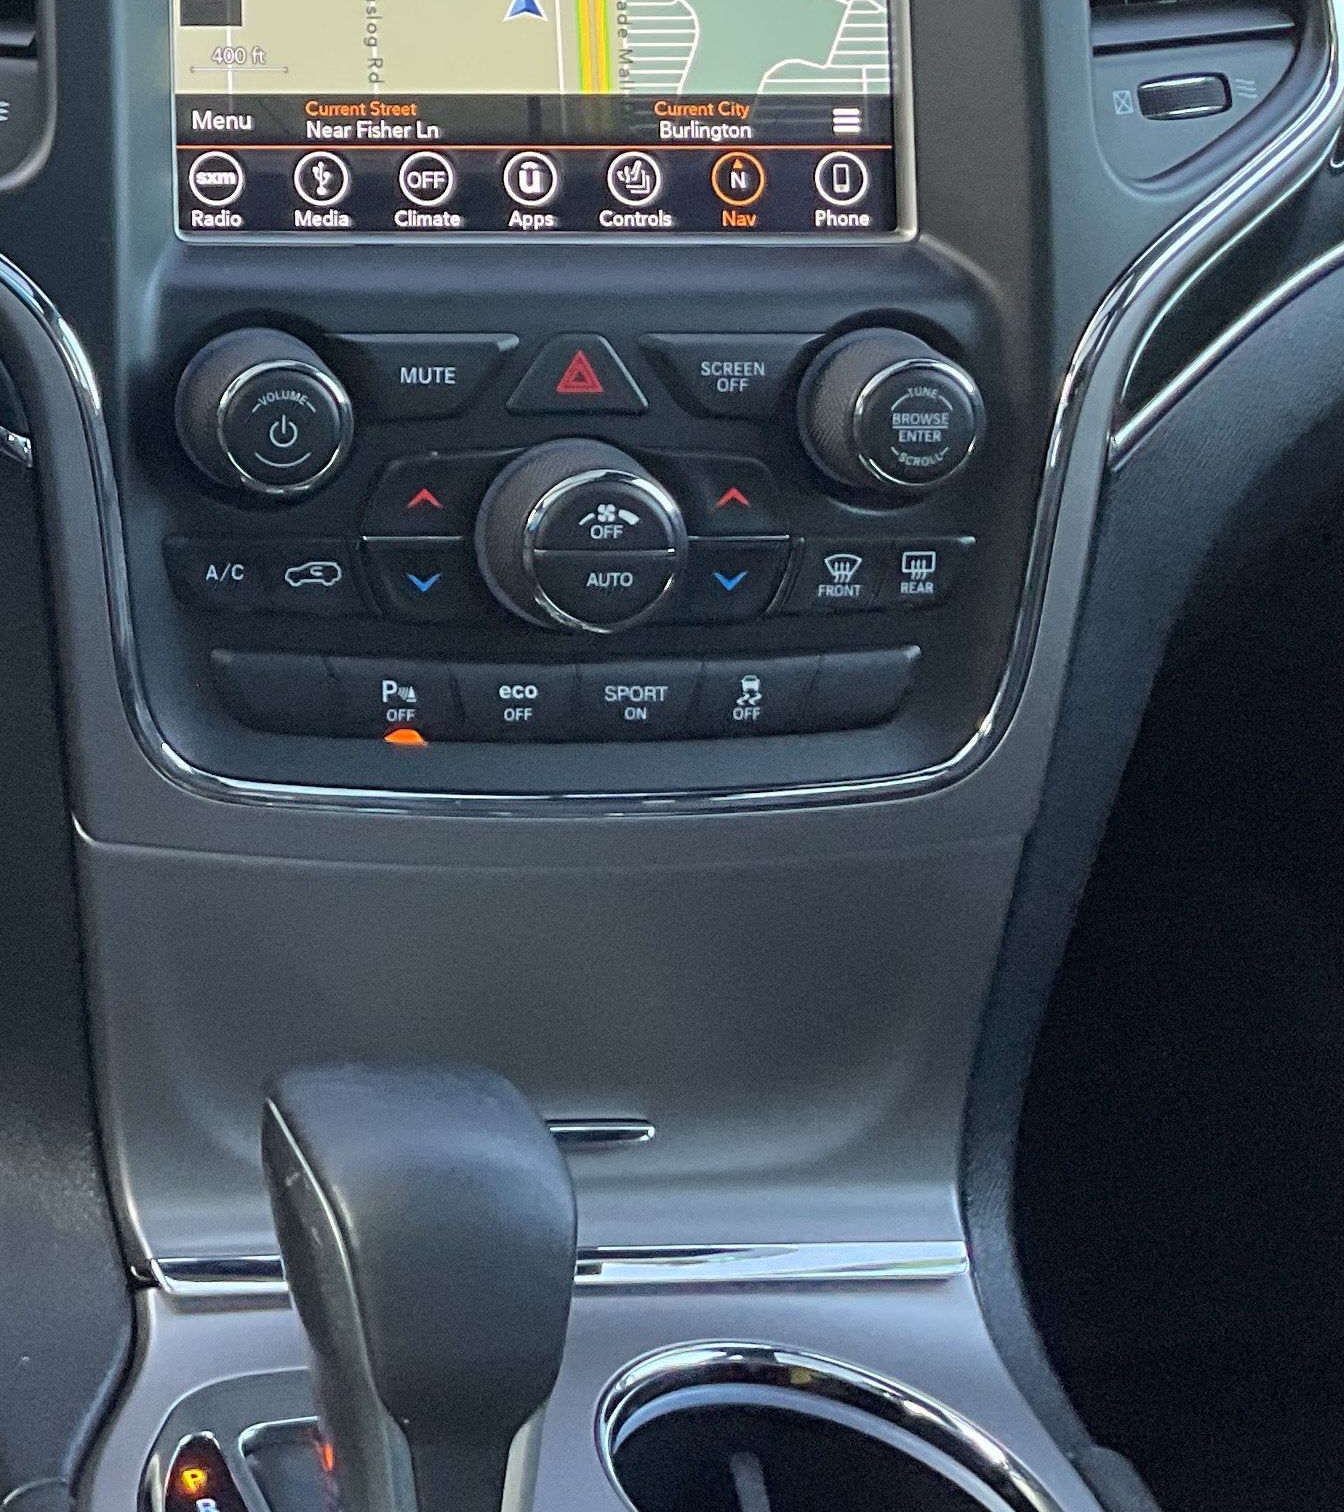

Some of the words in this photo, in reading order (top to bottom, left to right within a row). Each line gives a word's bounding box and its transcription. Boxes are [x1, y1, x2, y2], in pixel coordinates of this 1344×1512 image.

[211, 47, 247, 65] 400
[251, 46, 267, 65] ft
[367, 57, 385, 84] Rd
[305, 101, 365, 117] Current
[369, 101, 417, 116] Street
[654, 101, 713, 118] Current
[717, 101, 750, 120] City
[192, 111, 253, 131] Menu
[306, 121, 352, 139] Near
[356, 120, 412, 139] Fisher
[416, 121, 440, 139] Ln
[659, 120, 752, 143] Burlington
[195, 171, 236, 186] sxm
[407, 171, 445, 189] OFF
[731, 172, 746, 189] N
[191, 210, 243, 228] Radio
[294, 210, 350, 228] Media
[394, 210, 461, 228] Climate
[508, 211, 554, 231] Apps
[599, 210, 673, 228] Controls
[722, 211, 757, 227] Nav
[815, 210, 870, 228] Phone
[400, 366, 457, 385] MUTE
[700, 361, 765, 377] SCREEN
[716, 377, 749, 393] OFF
[908, 386, 939, 398] TUNE
[257, 389, 310, 406] VOLUME
[892, 412, 950, 425] BROWSE
[898, 428, 942, 443] ENTER
[897, 451, 944, 467] SCROLL
[590, 524, 624, 539] OFF
[205, 563, 245, 582] A/C
[586, 572, 634, 587] AUTO
[818, 584, 862, 598] FRONT
[900, 582, 934, 594] REAR
[498, 685, 538, 700] eco
[604, 686, 669, 702] SPORT
[386, 708, 416, 723] OFF
[503, 707, 533, 722] OFF
[624, 707, 647, 721] ON
[733, 707, 762, 721] OFF
[182, 1468, 205, 1489] P
